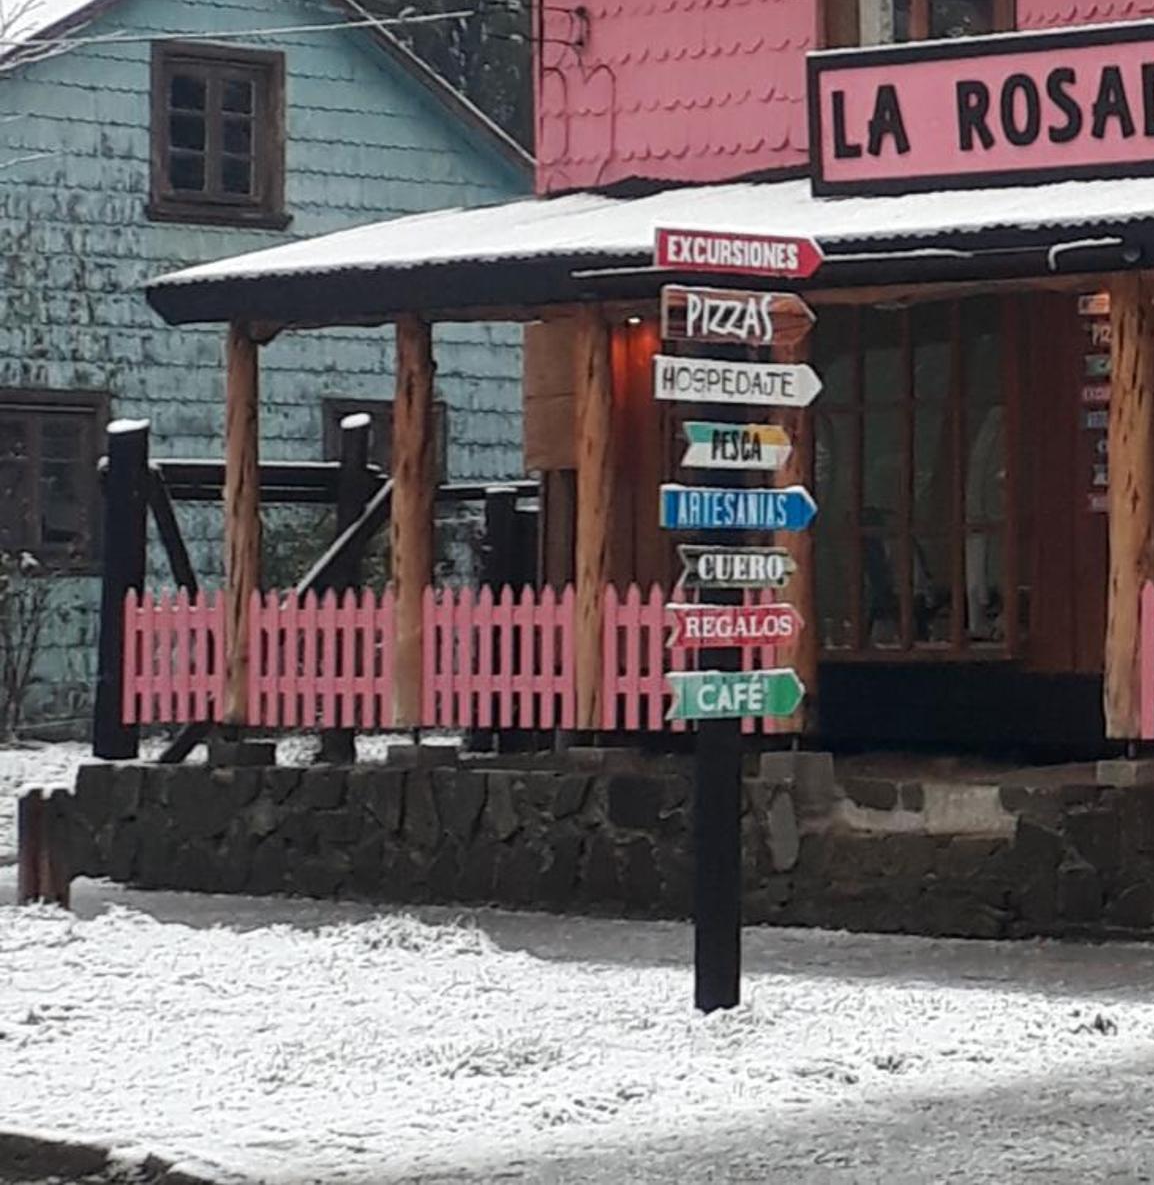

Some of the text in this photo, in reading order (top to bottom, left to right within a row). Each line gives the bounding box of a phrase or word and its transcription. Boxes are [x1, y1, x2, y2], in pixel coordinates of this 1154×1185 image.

[831, 84, 911, 160] LA
[666, 235, 800, 271] EXCURSIONES
[686, 292, 774, 342] PIZZAS
[662, 366, 796, 398] HOSPEDAJE
[711, 428, 763, 462] PESCA
[677, 491, 788, 526] ARTESANIAS
[697, 554, 785, 581] CUERO
[684, 616, 793, 638] REGALOS
[696, 676, 763, 712] CAFÉ
